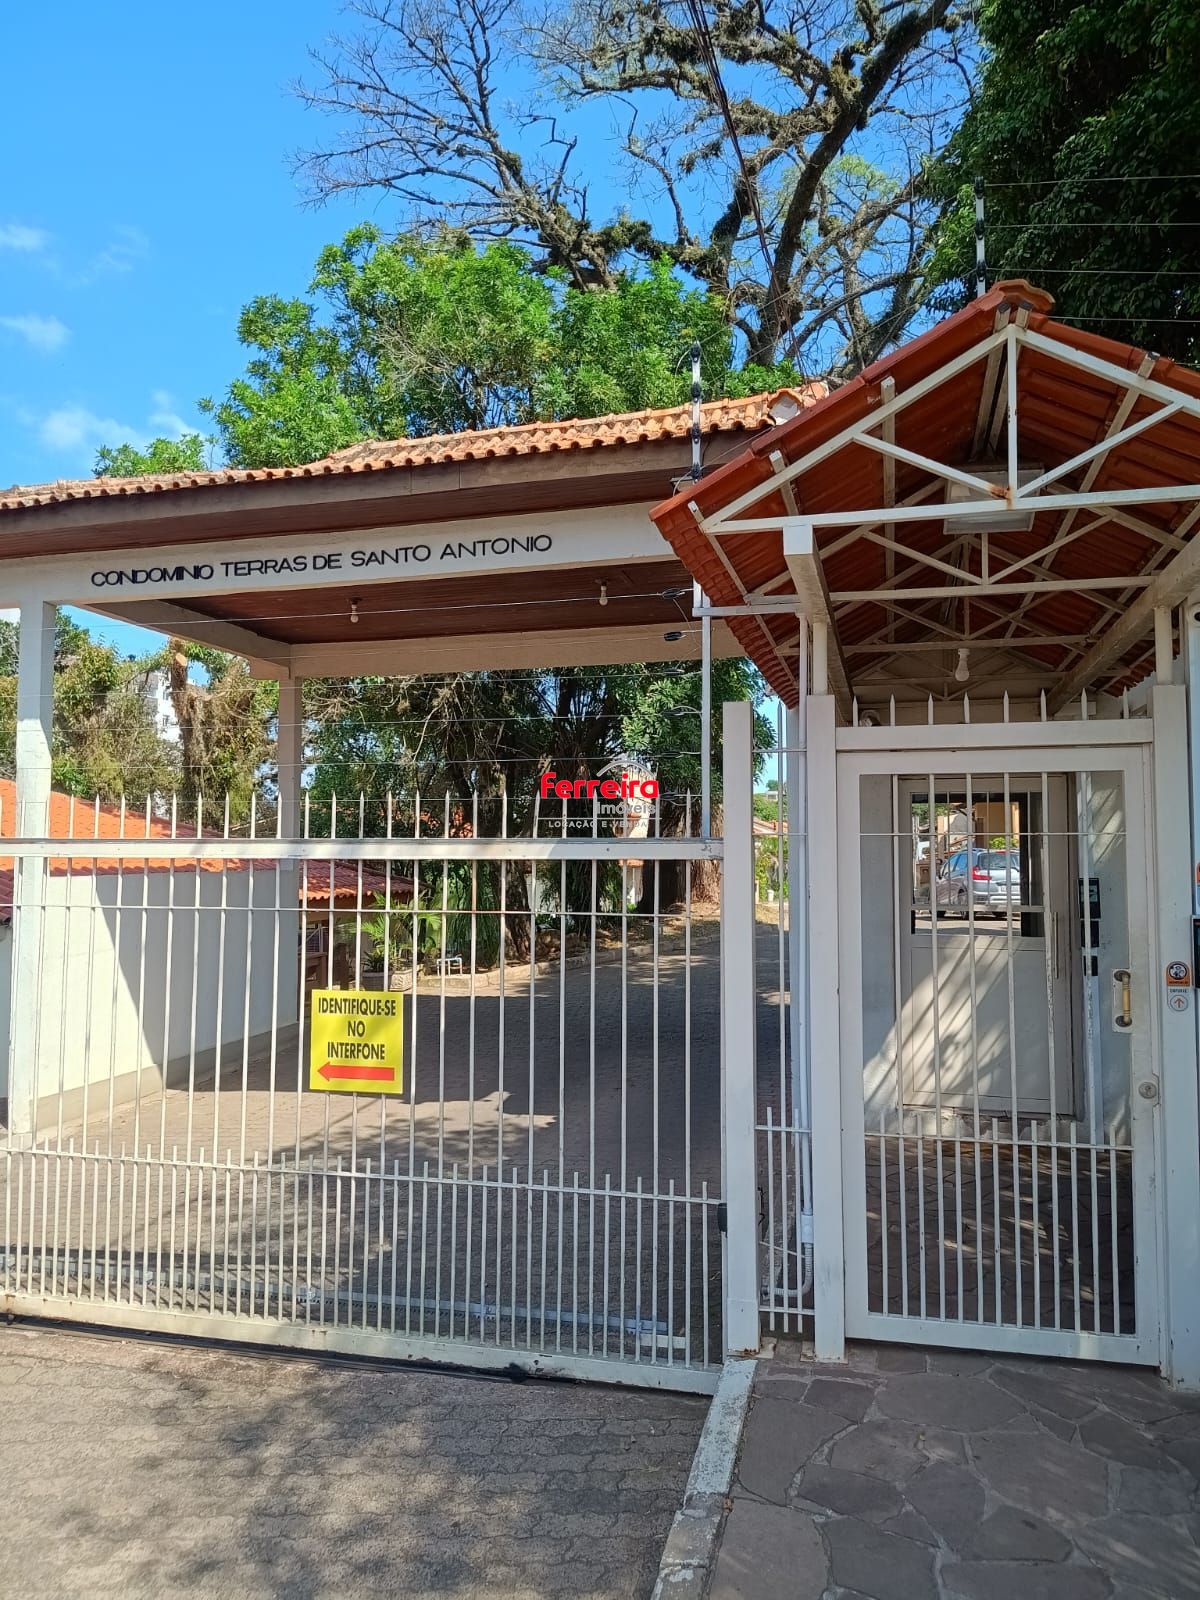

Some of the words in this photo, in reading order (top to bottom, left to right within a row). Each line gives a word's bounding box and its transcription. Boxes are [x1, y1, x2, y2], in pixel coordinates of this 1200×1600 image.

[91, 564, 214, 587] CONDOMINIO
[220, 556, 307, 577] TERRAS
[312, 553, 342, 570] DE
[351, 545, 432, 567] SANTO
[440, 534, 552, 560] ANTONIO
[318, 997, 396, 1017] IDENTIFIQUE-SE
[347, 1020, 366, 1038] NO
[327, 1041, 386, 1060] INTERFONE
